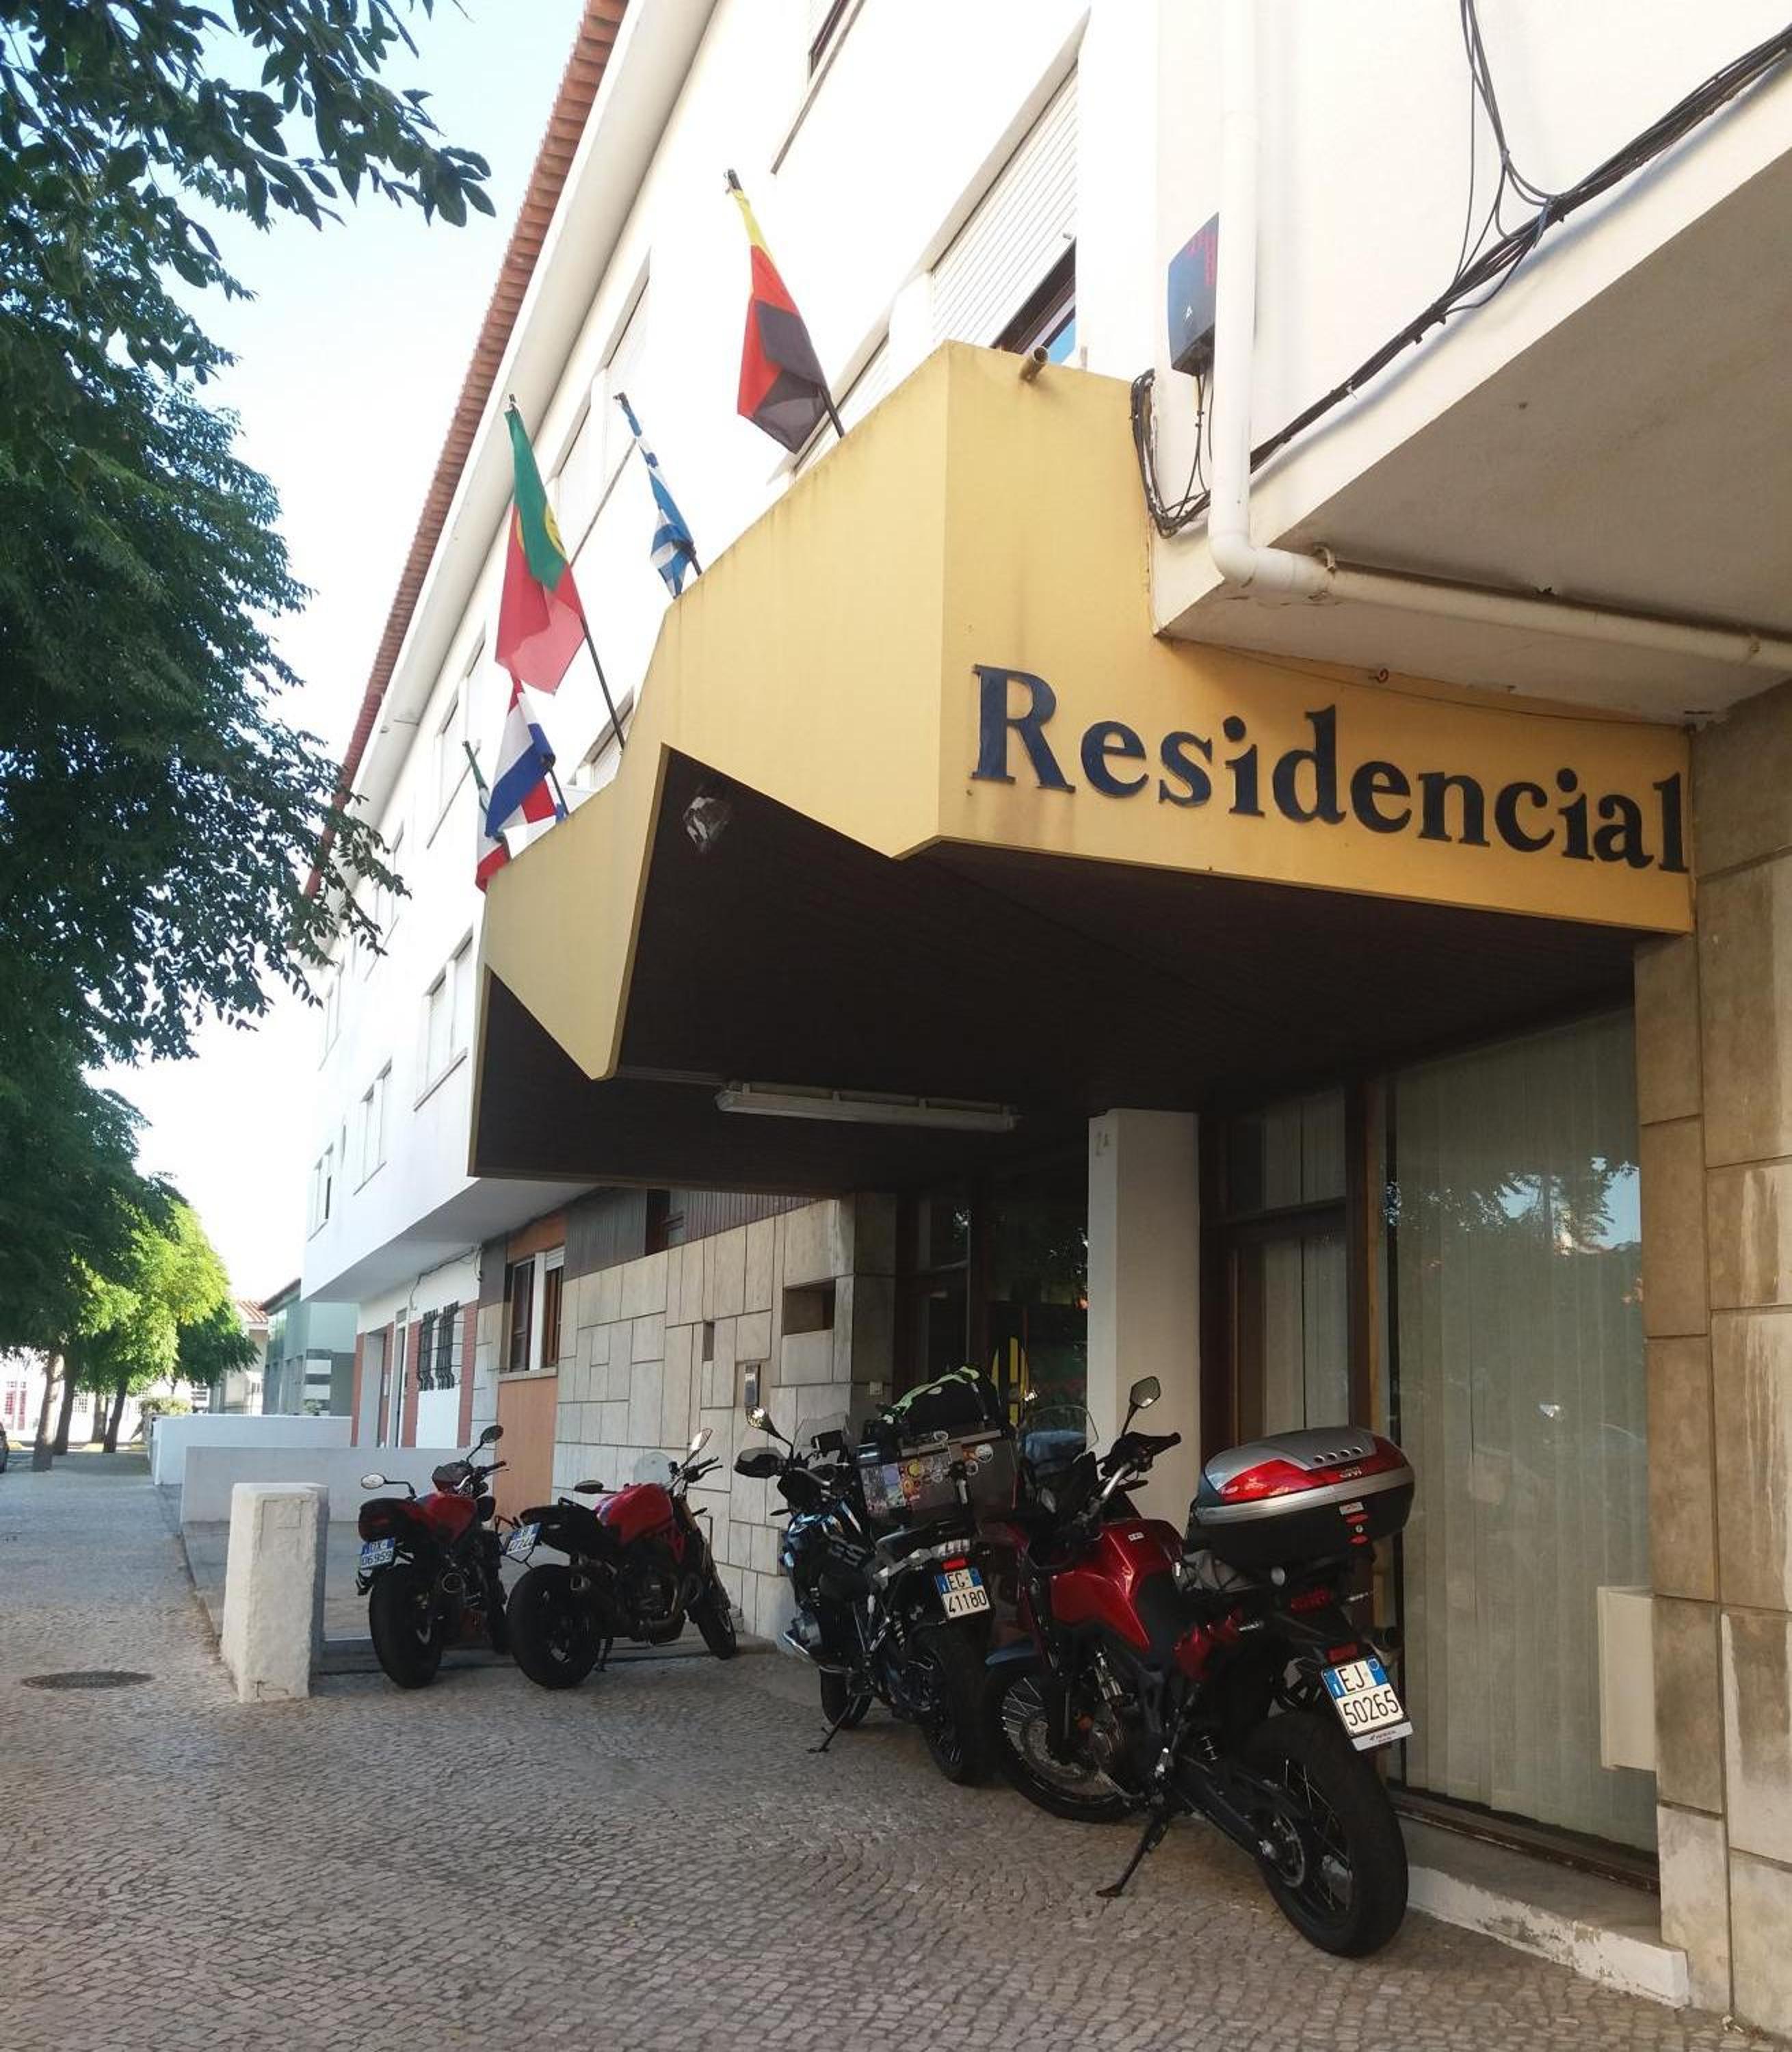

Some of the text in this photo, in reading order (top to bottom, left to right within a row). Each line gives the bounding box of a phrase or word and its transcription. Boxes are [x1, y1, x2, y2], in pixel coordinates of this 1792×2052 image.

[972, 664, 1688, 873] Residencial
[949, 1590, 987, 1614] 41180
[1337, 1664, 1365, 1692] EJ
[1343, 1689, 1399, 1726] 50265
